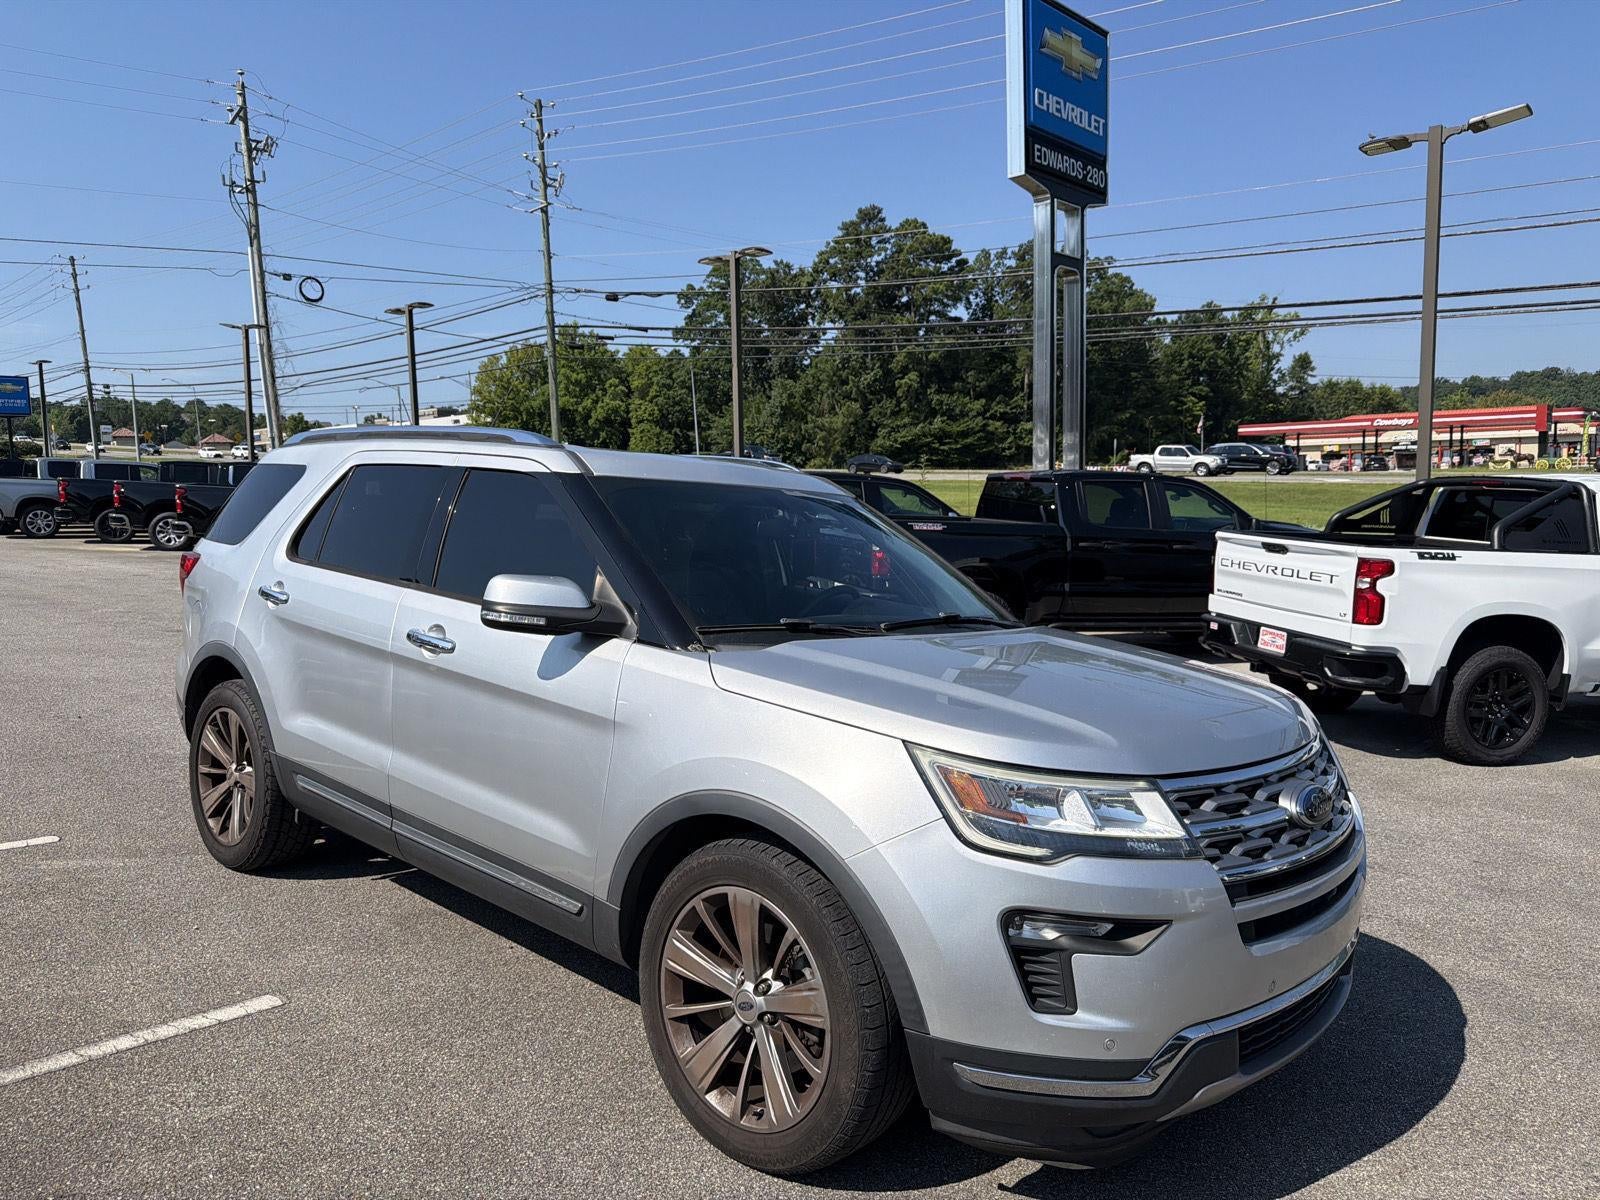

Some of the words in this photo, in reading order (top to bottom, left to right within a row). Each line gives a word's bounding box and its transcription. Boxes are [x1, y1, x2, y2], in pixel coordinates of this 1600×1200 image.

[1034, 87, 1105, 136] CHEVROLET
[1373, 418, 1414, 426] Cowboys
[1220, 557, 1340, 584] CHEVROLET
